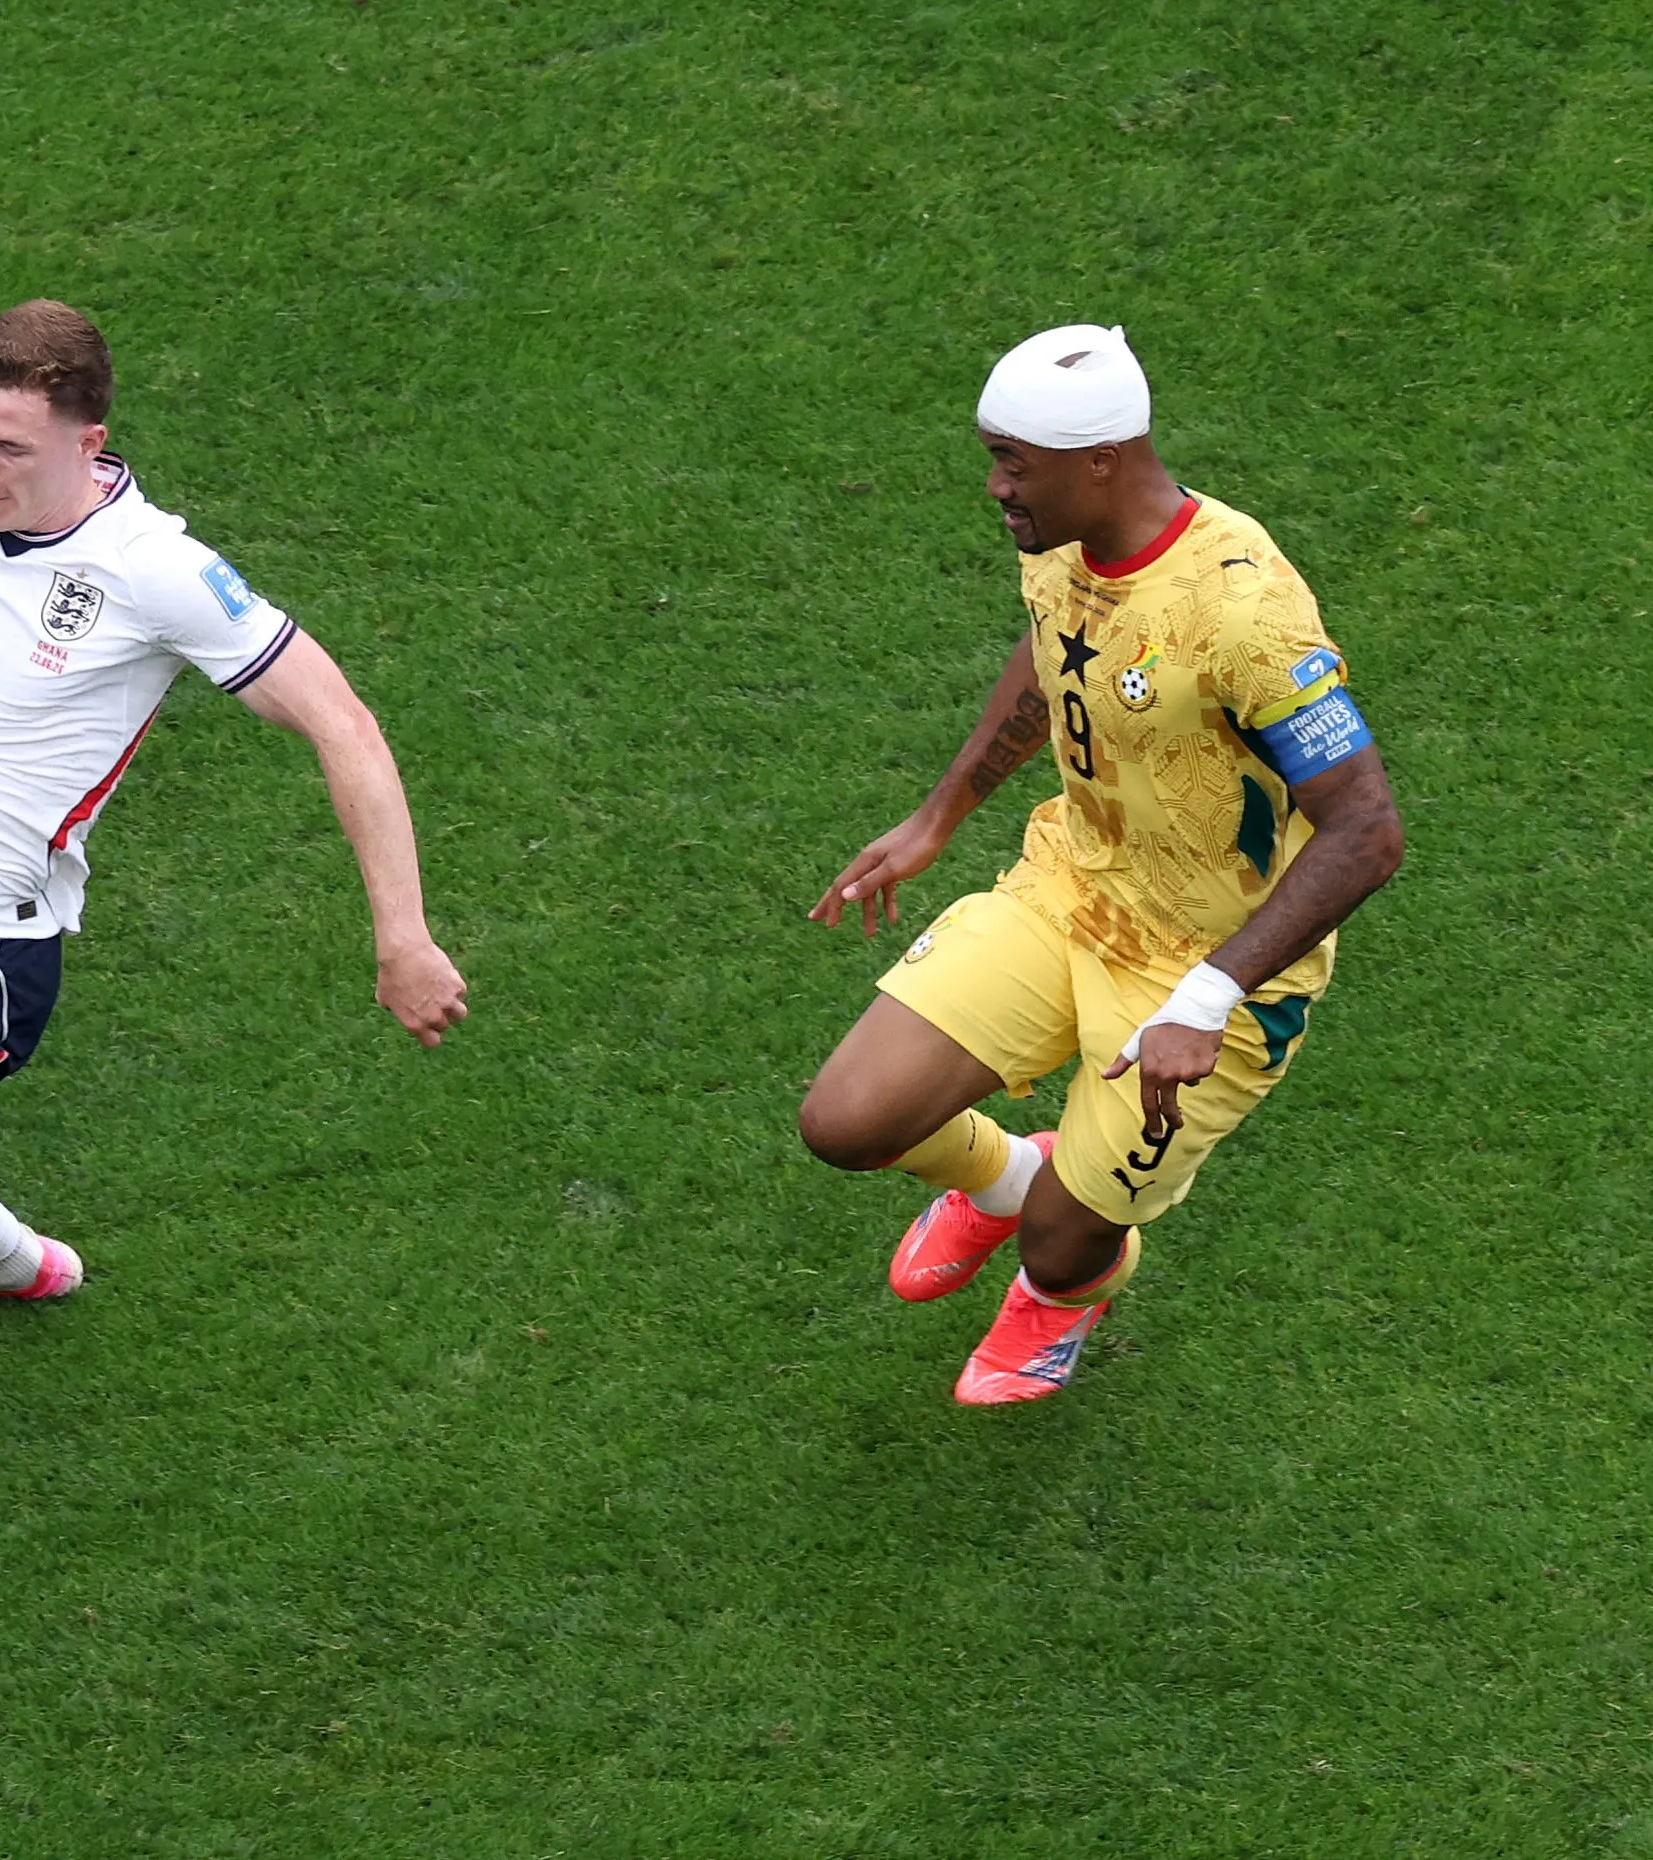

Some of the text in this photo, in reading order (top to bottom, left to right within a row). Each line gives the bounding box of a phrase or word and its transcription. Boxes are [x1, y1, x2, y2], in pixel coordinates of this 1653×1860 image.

[36, 640, 68, 661] GHANA
[1287, 695, 1343, 732] FOOTBALL
[1293, 703, 1351, 744] UNITES
[1063, 689, 1095, 781] 9
[1300, 715, 1360, 759] the World
